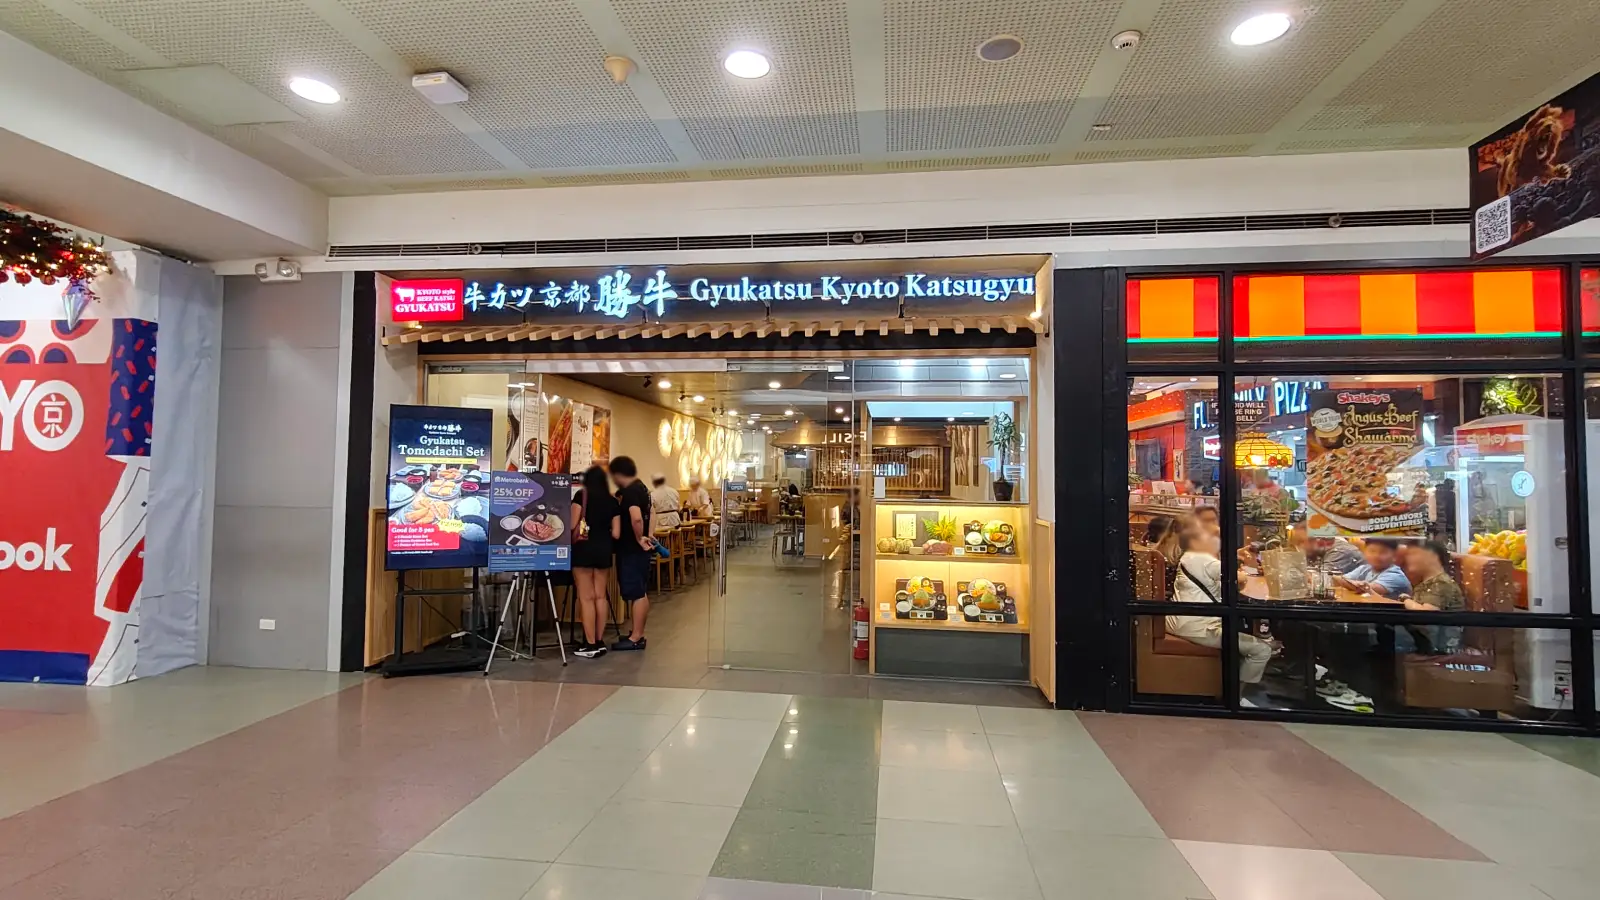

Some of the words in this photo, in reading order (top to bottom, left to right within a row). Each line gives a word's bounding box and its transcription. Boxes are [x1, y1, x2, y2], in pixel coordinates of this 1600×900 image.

[442, 288, 456, 296] style
[690, 277, 813, 307] Gyukatsu
[820, 276, 899, 304] Kyoto
[904, 273, 1035, 302] Katsugyu
[394, 303, 456, 312] GYUKATSU
[1337, 393, 1390, 405] Shakey's
[1343, 404, 1384, 426] Angus
[1383, 403, 1420, 428] Beef
[420, 436, 465, 446] Gyukatsu
[1343, 426, 1418, 448] Shawarma
[398, 444, 463, 456] Tomodachi
[466, 446, 485, 457] Set
[494, 488, 513, 497] 25%
[515, 488, 534, 497] OFF
[1369, 517, 1390, 525] BOLD
[1391, 512, 1423, 523] FLAVORS
